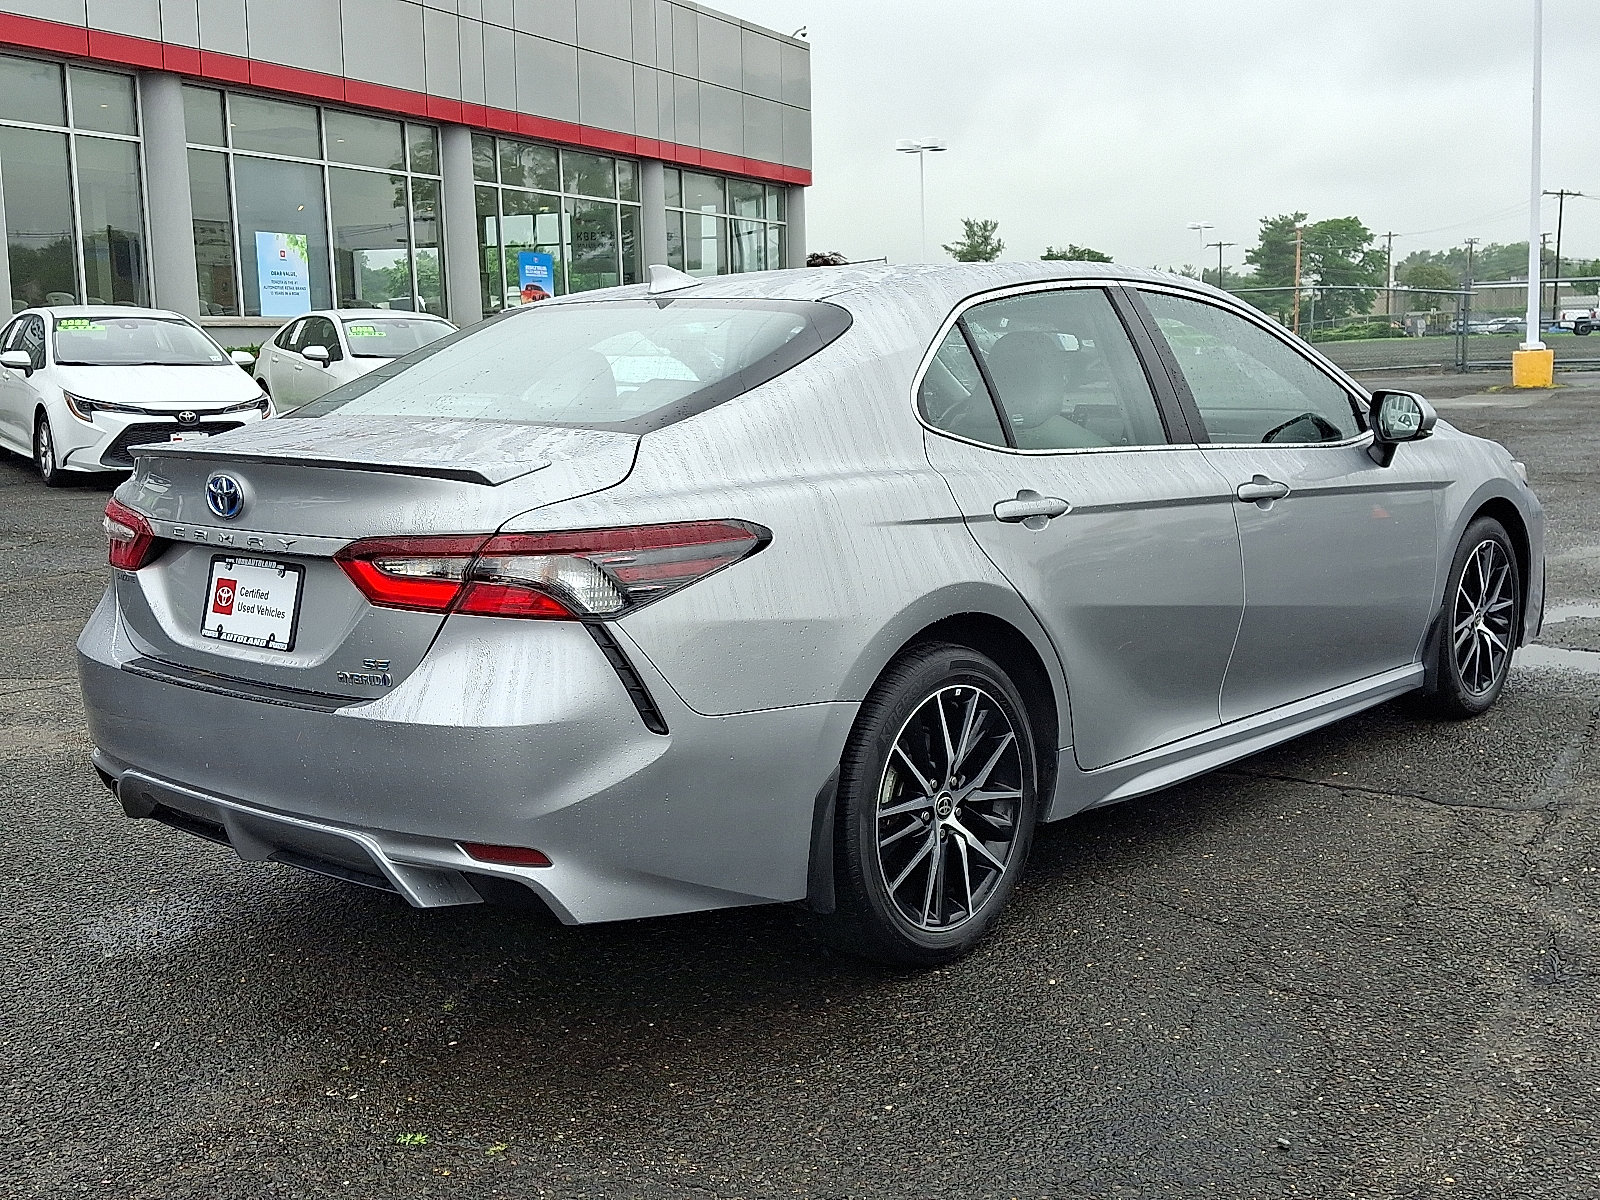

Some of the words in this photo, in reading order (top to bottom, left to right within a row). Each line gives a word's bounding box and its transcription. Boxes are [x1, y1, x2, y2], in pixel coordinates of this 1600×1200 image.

[173, 526, 297, 550] CAMRY
[240, 586, 270, 600] Certified
[238, 602, 255, 613] Used
[257, 605, 285, 619] Vehicles
[220, 632, 266, 646] AUTOLAND
[361, 658, 390, 671] SE
[336, 670, 382, 686] HYBRID
